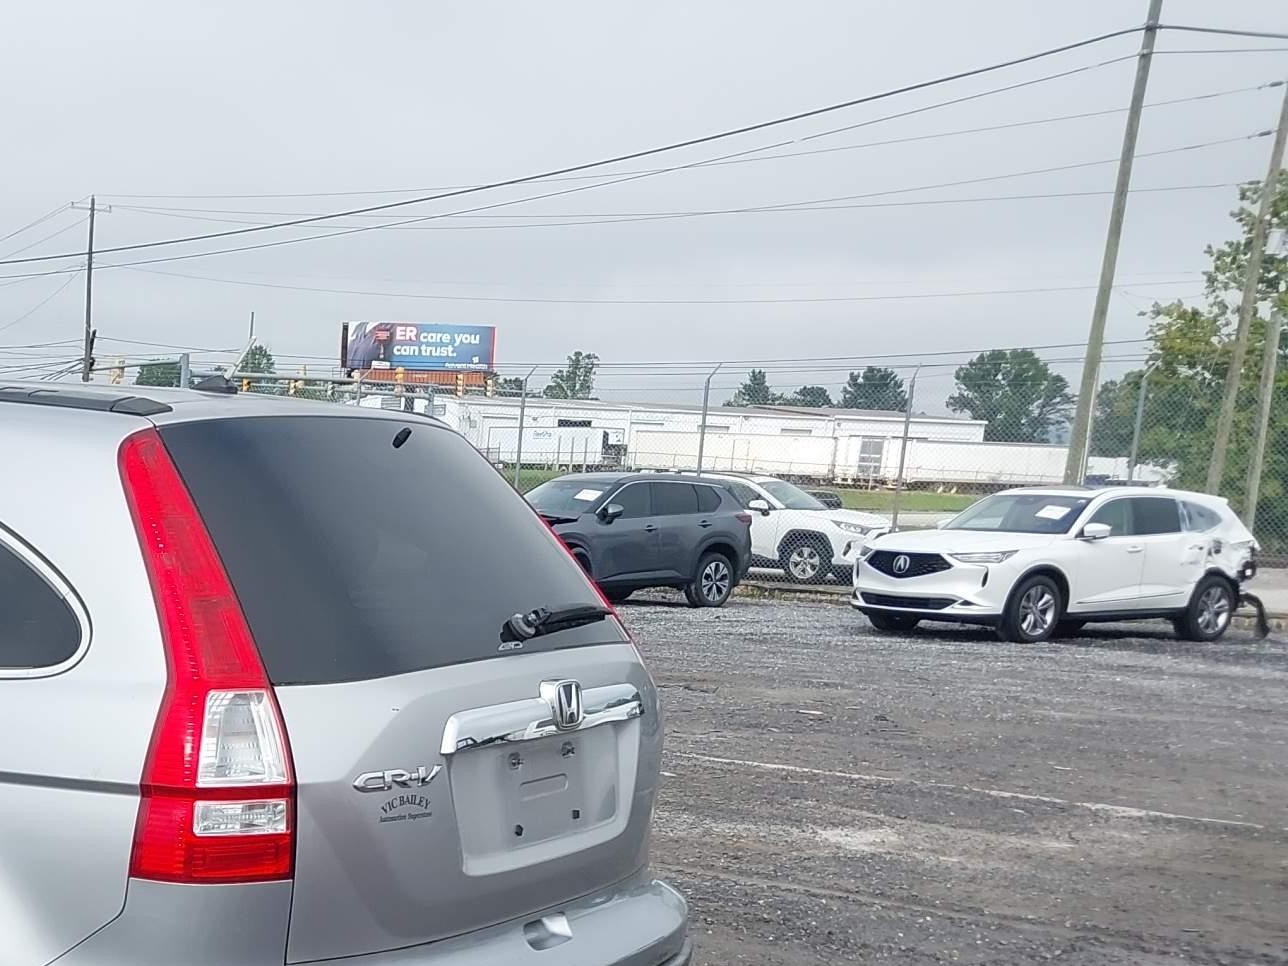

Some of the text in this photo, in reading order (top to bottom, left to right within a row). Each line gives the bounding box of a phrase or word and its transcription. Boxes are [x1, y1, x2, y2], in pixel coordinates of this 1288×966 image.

[396, 327, 417, 341] ER
[420, 333, 451, 343] care
[453, 333, 480, 345] you
[393, 345, 456, 357] can trust.
[352, 764, 443, 793] CR-V
[381, 794, 431, 814] VIC BAILEY
